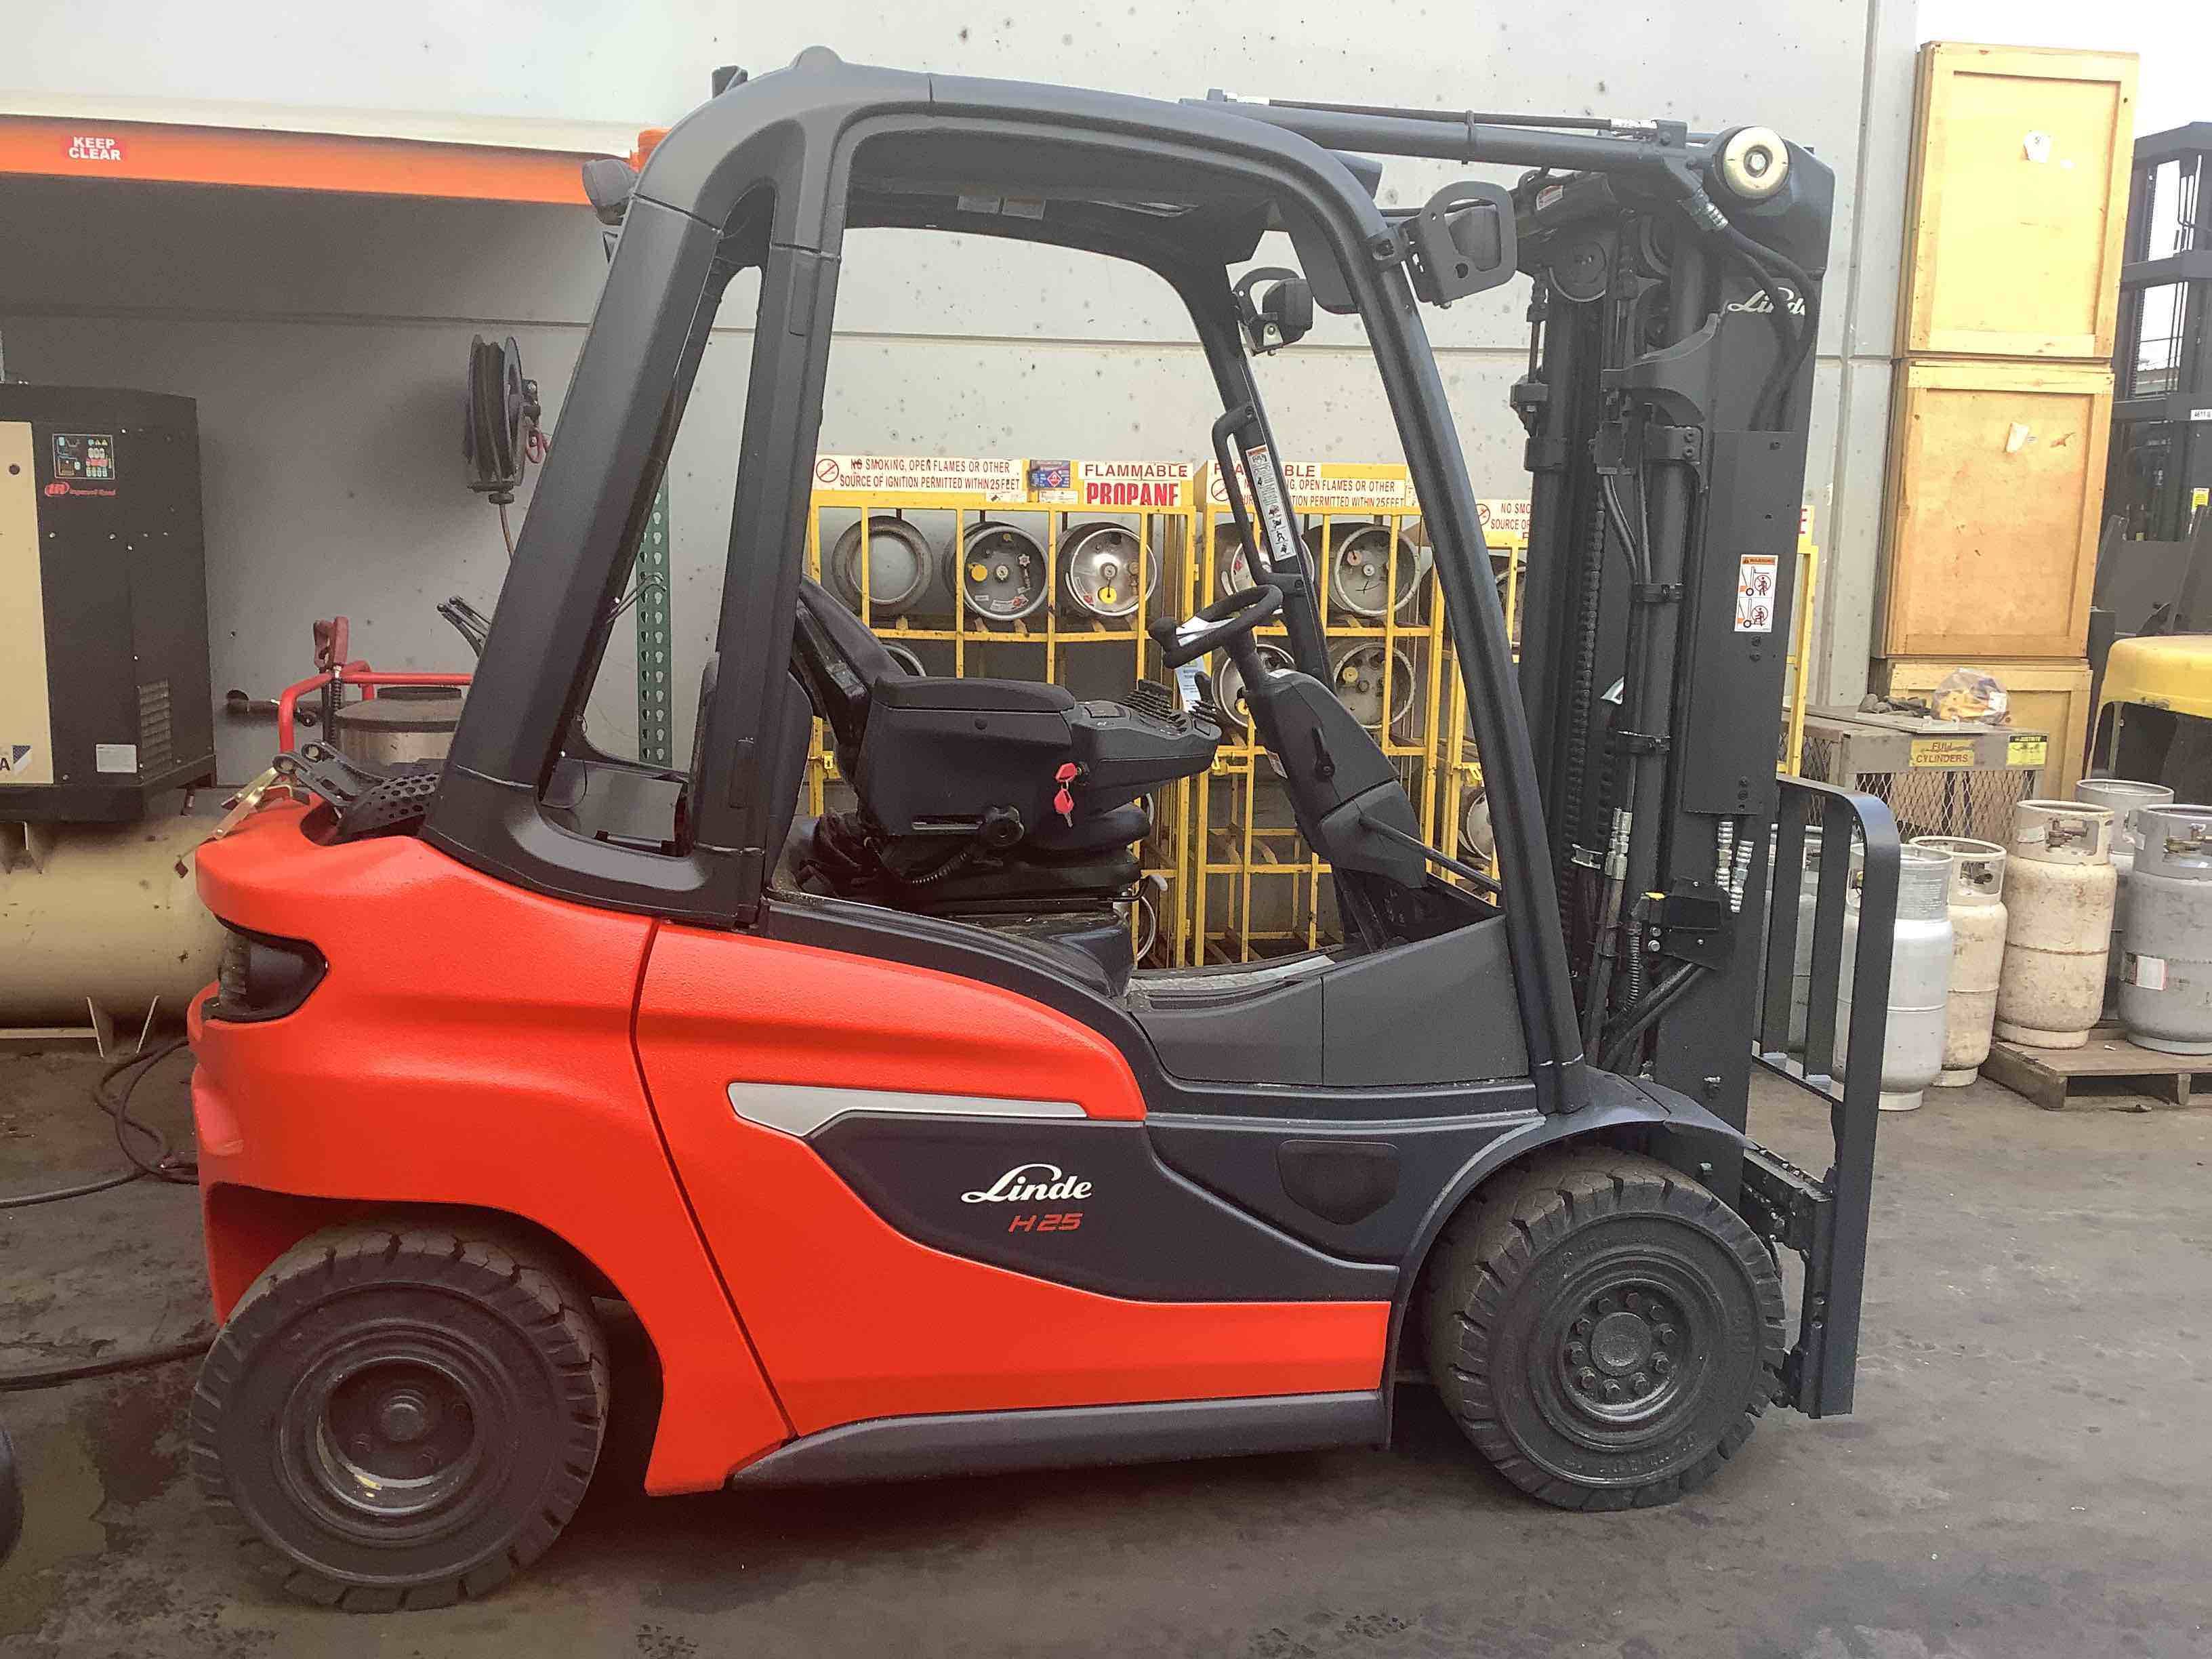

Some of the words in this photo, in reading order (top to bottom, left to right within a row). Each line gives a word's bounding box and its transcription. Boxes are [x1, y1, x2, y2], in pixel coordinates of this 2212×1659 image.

[73, 136, 115, 149] KEEP
[68, 147, 121, 161] CLEAR
[851, 458, 862, 470] NO
[865, 459, 907, 472] SMOKING,
[909, 459, 931, 471] OPEN
[933, 460, 966, 472] FLAMES
[968, 461, 980, 472] OR
[983, 462, 1010, 473] OTHER
[1085, 464, 1187, 477] FLAMMABLE
[840, 474, 872, 487] SOURCE
[873, 476, 884, 487] OF
[886, 476, 918, 487] IGNITION
[921, 476, 962, 489] PERMITTED
[1299, 479, 1319, 490] OPEN
[1322, 480, 1353, 491] FLAMES
[1355, 480, 1366, 491] OR
[1369, 481, 1395, 492] OTHER
[1086, 483, 1179, 506] PROPANE
[1310, 495, 1349, 507] PERMITTED
[1501, 503, 1512, 513] NO
[1491, 519, 1519, 529] SOURCE
[1916, 754, 1969, 763] CYLINDERS
[961, 1163, 1092, 1203] Linde
